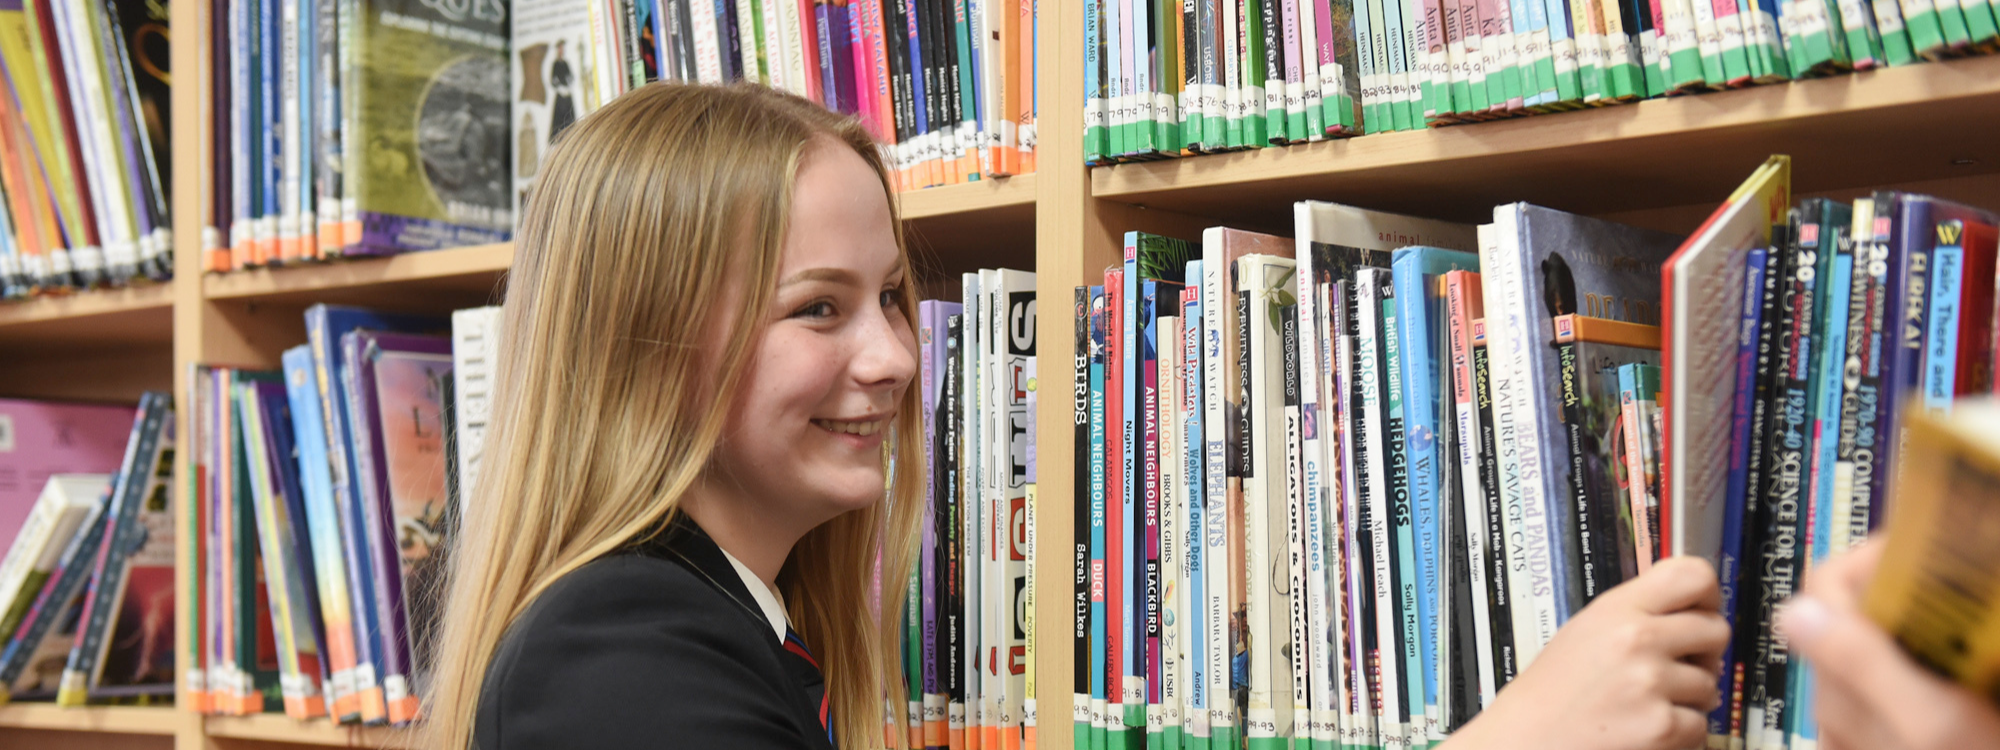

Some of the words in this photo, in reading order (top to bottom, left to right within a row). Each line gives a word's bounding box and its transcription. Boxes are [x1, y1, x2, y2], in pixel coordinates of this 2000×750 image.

[1087, 3, 1095, 32] BRIAN
[1427, 7, 1438, 41] Anita
[1446, 8, 1457, 42] Anita
[1463, 5, 1475, 37] Anita
[874, 33, 887, 96] ZEALAND
[1088, 36, 1096, 63] WARD
[1322, 43, 1331, 65] WAY
[1379, 231, 1420, 245] animal
[1763, 246, 1778, 309] ANIMAL
[1796, 250, 1816, 282] 20
[1868, 243, 1889, 277] 20
[1936, 253, 1957, 298] Hair,
[1104, 291, 1112, 308] The
[1208, 271, 1216, 327] NATURE
[1188, 327, 1198, 355] Wild
[1239, 296, 1248, 386] EYEWITNESS
[1385, 316, 1397, 353] British
[1758, 321, 1772, 376] STORY
[1934, 304, 1954, 357] There
[1285, 320, 1295, 396] WILDWORLD
[1323, 338, 1331, 376] GIRAFFE
[1361, 337, 1377, 407] MOOSE
[1559, 345, 1575, 407] InfoSearch
[1075, 354, 1087, 425] BIRDS
[1188, 359, 1199, 418] Predators
[1209, 363, 1218, 411] WATCH
[1388, 356, 1401, 401] Wildlife
[1474, 349, 1491, 409] InfoSearch
[1933, 364, 1951, 398] and
[1092, 390, 1102, 439] ANIMAL
[1145, 386, 1155, 436] ANIMAL
[1161, 359, 1171, 459] ORNITHOLOGY
[1497, 378, 1517, 457] NATURE'S
[1625, 408, 1635, 437] Animals
[1782, 388, 1805, 449] 1920-40
[1839, 392, 1858, 458] GUIDES
[1855, 384, 1878, 447] 1970-90
[1125, 420, 1133, 455] Night
[1241, 418, 1250, 472] GUIDES
[1459, 411, 1471, 465] Marsupials
[1484, 426, 1492, 456] Animal
[1517, 421, 1537, 481] BEARS
[1571, 423, 1580, 455] Animal
[948, 470, 956, 503] Ending
[1092, 443, 1103, 527] NEIGHBOURS
[1146, 441, 1156, 526] NEIGHBOURS
[1190, 449, 1199, 486] Wolves
[1288, 416, 1298, 544] ALLIGATORS
[1391, 417, 1409, 527] HEDGEHOGS
[1486, 458, 1496, 489] Groups
[1574, 456, 1584, 488] Groups
[1778, 451, 1801, 522] SCIENCE
[1191, 488, 1199, 508] and
[1208, 439, 1226, 548] ELEPHANTS
[1415, 456, 1432, 529] WHALES,
[1490, 496, 1498, 513] Life
[1504, 462, 1523, 525] SAVAGE
[1525, 486, 1541, 518] and
[1578, 494, 1587, 512] Life
[948, 505, 956, 539] Poverty
[1164, 520, 1171, 529] &
[1191, 512, 1200, 544] Other
[1307, 461, 1321, 572] chimpanzees
[1491, 514, 1499, 522] in
[1579, 513, 1588, 522] in
[1164, 530, 1172, 563] GIBBS
[1191, 546, 1200, 572] Dogs
[1293, 551, 1300, 566] &
[1374, 520, 1383, 563] Michael
[1493, 532, 1502, 550] Mob
[1511, 531, 1527, 572] CATS
[1529, 523, 1550, 597] PANDAS
[1581, 531, 1590, 554] Band
[1774, 525, 1797, 559] FOR
[1077, 543, 1086, 584] Sarah
[1093, 563, 1103, 597] DUCK
[1377, 567, 1387, 598] Leach
[1422, 532, 1436, 594] DOLPHINS
[1495, 560, 1506, 605] Kangaroos
[1585, 563, 1595, 597] Gorillas
[1771, 563, 1794, 600] THE
[1077, 592, 1086, 637] Wilkes
[1147, 563, 1157, 633] BLACKBIRD
[1405, 583, 1415, 611] Sally
[1293, 575, 1303, 701] CROCODILES
[1406, 614, 1416, 657] Morgan
[1214, 644, 1222, 685] TAYLOR
[1503, 646, 1511, 673] Richard
